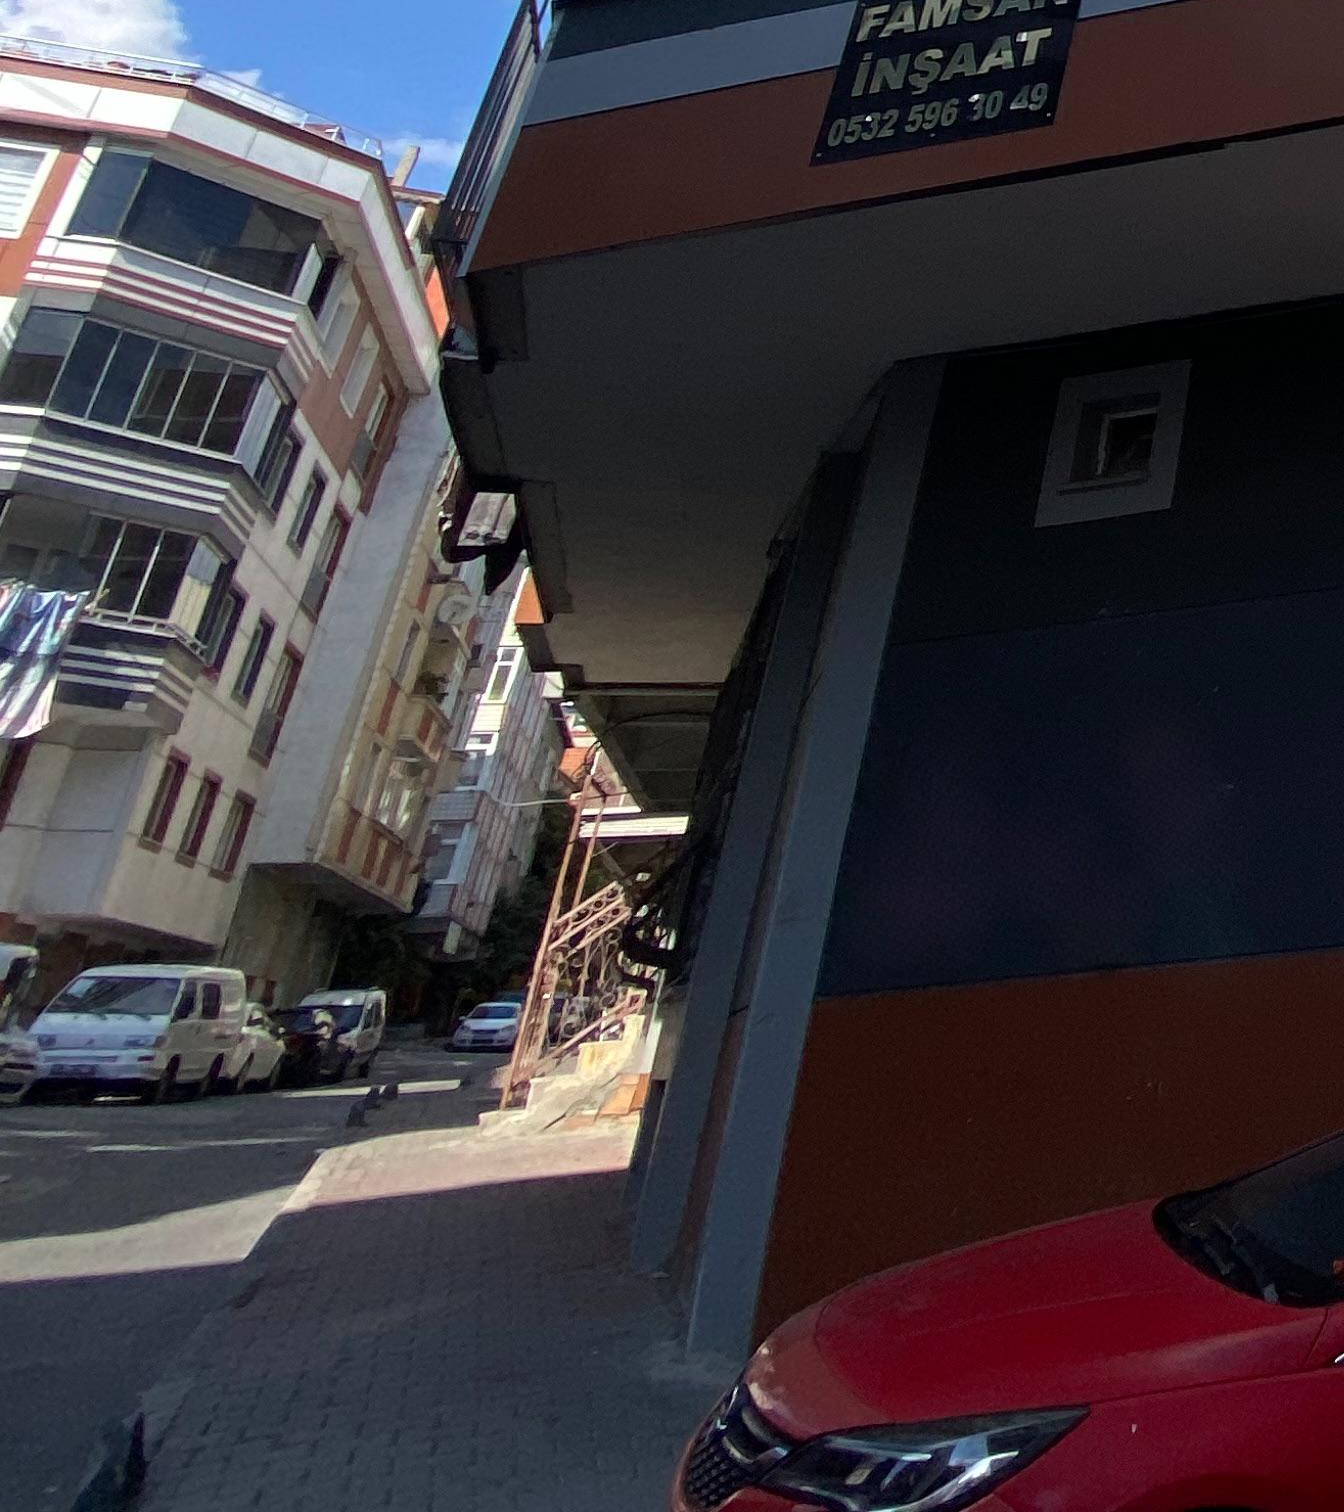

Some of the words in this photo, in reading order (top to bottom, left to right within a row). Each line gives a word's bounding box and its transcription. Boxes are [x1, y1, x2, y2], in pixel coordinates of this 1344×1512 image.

[850, 27, 1053, 98] İNŞAAT
[827, 108, 899, 148] 0532
[904, 97, 960, 134] 596
[967, 89, 1004, 122] 30
[1009, 82, 1049, 112] 49
